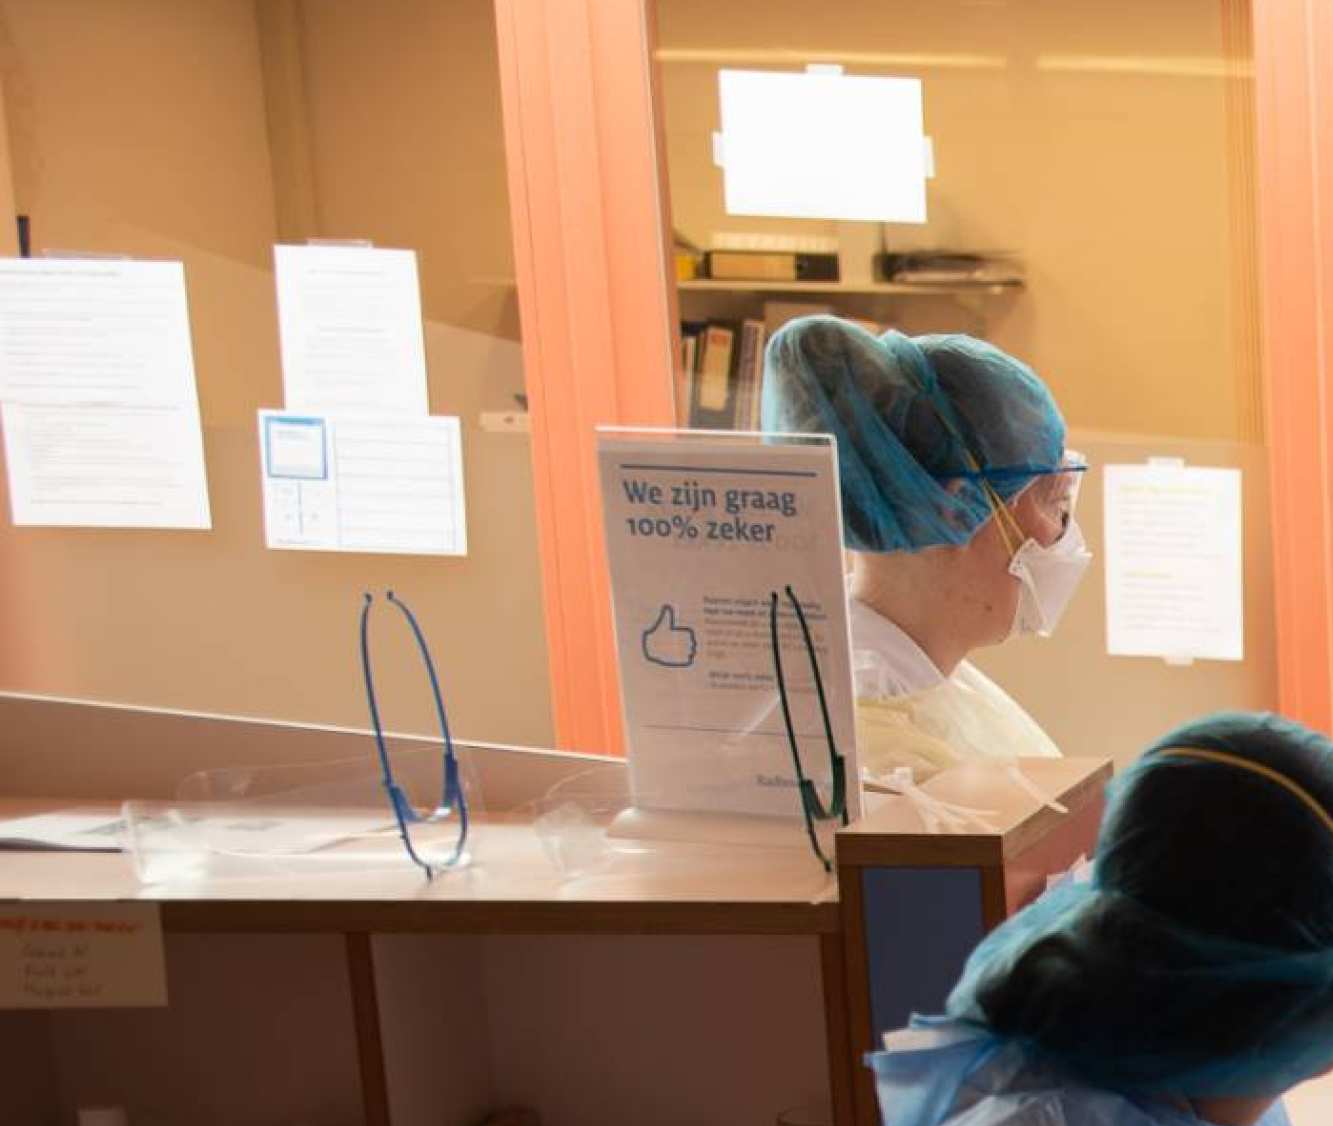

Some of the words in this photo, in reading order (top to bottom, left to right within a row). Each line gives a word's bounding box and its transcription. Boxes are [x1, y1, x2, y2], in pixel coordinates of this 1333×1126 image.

[624, 480, 664, 504] We
[671, 480, 716, 512] zijn
[725, 488, 797, 517] graag
[626, 515, 699, 539] 100%
[706, 517, 775, 542] zeker
